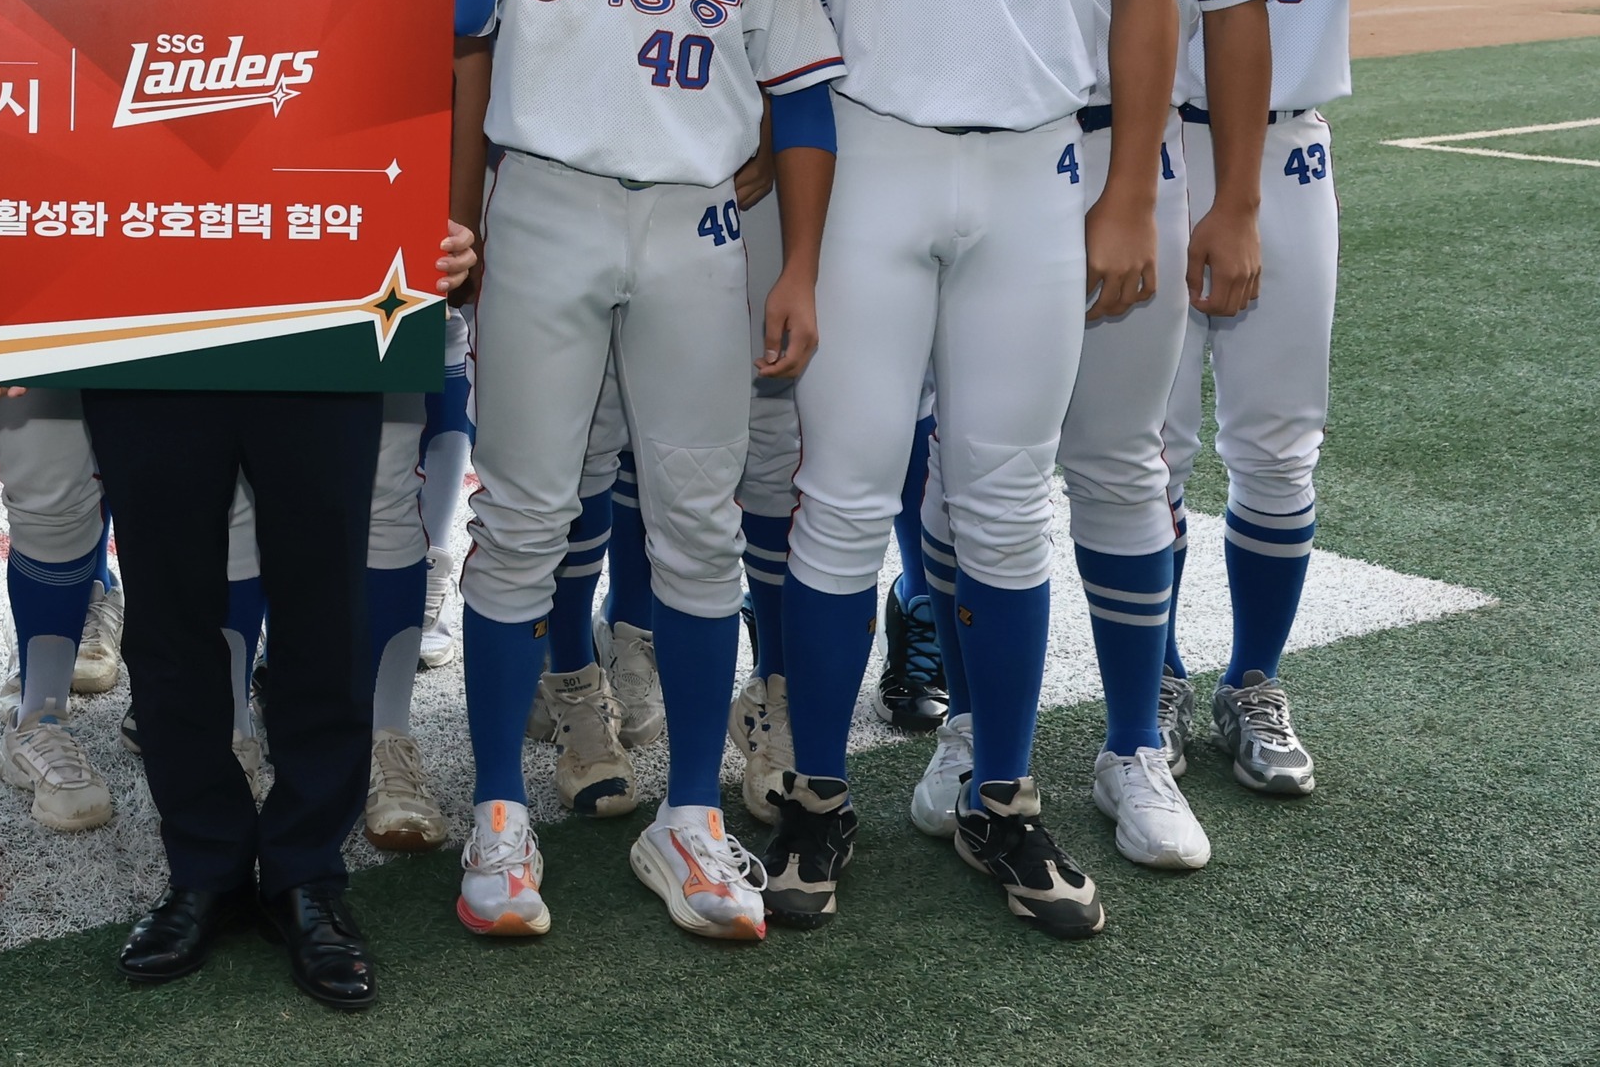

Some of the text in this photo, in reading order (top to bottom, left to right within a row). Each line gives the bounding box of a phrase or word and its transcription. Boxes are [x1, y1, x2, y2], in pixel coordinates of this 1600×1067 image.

[156, 34, 204, 54] SSG
[638, 30, 714, 90] 40
[112, 35, 319, 129] Landers
[1057, 143, 1080, 184] 4
[1284, 142, 1326, 185] 43
[120, 201, 272, 240] 상호협력
[286, 203, 362, 240] 협약
[698, 199, 740, 247] 40
